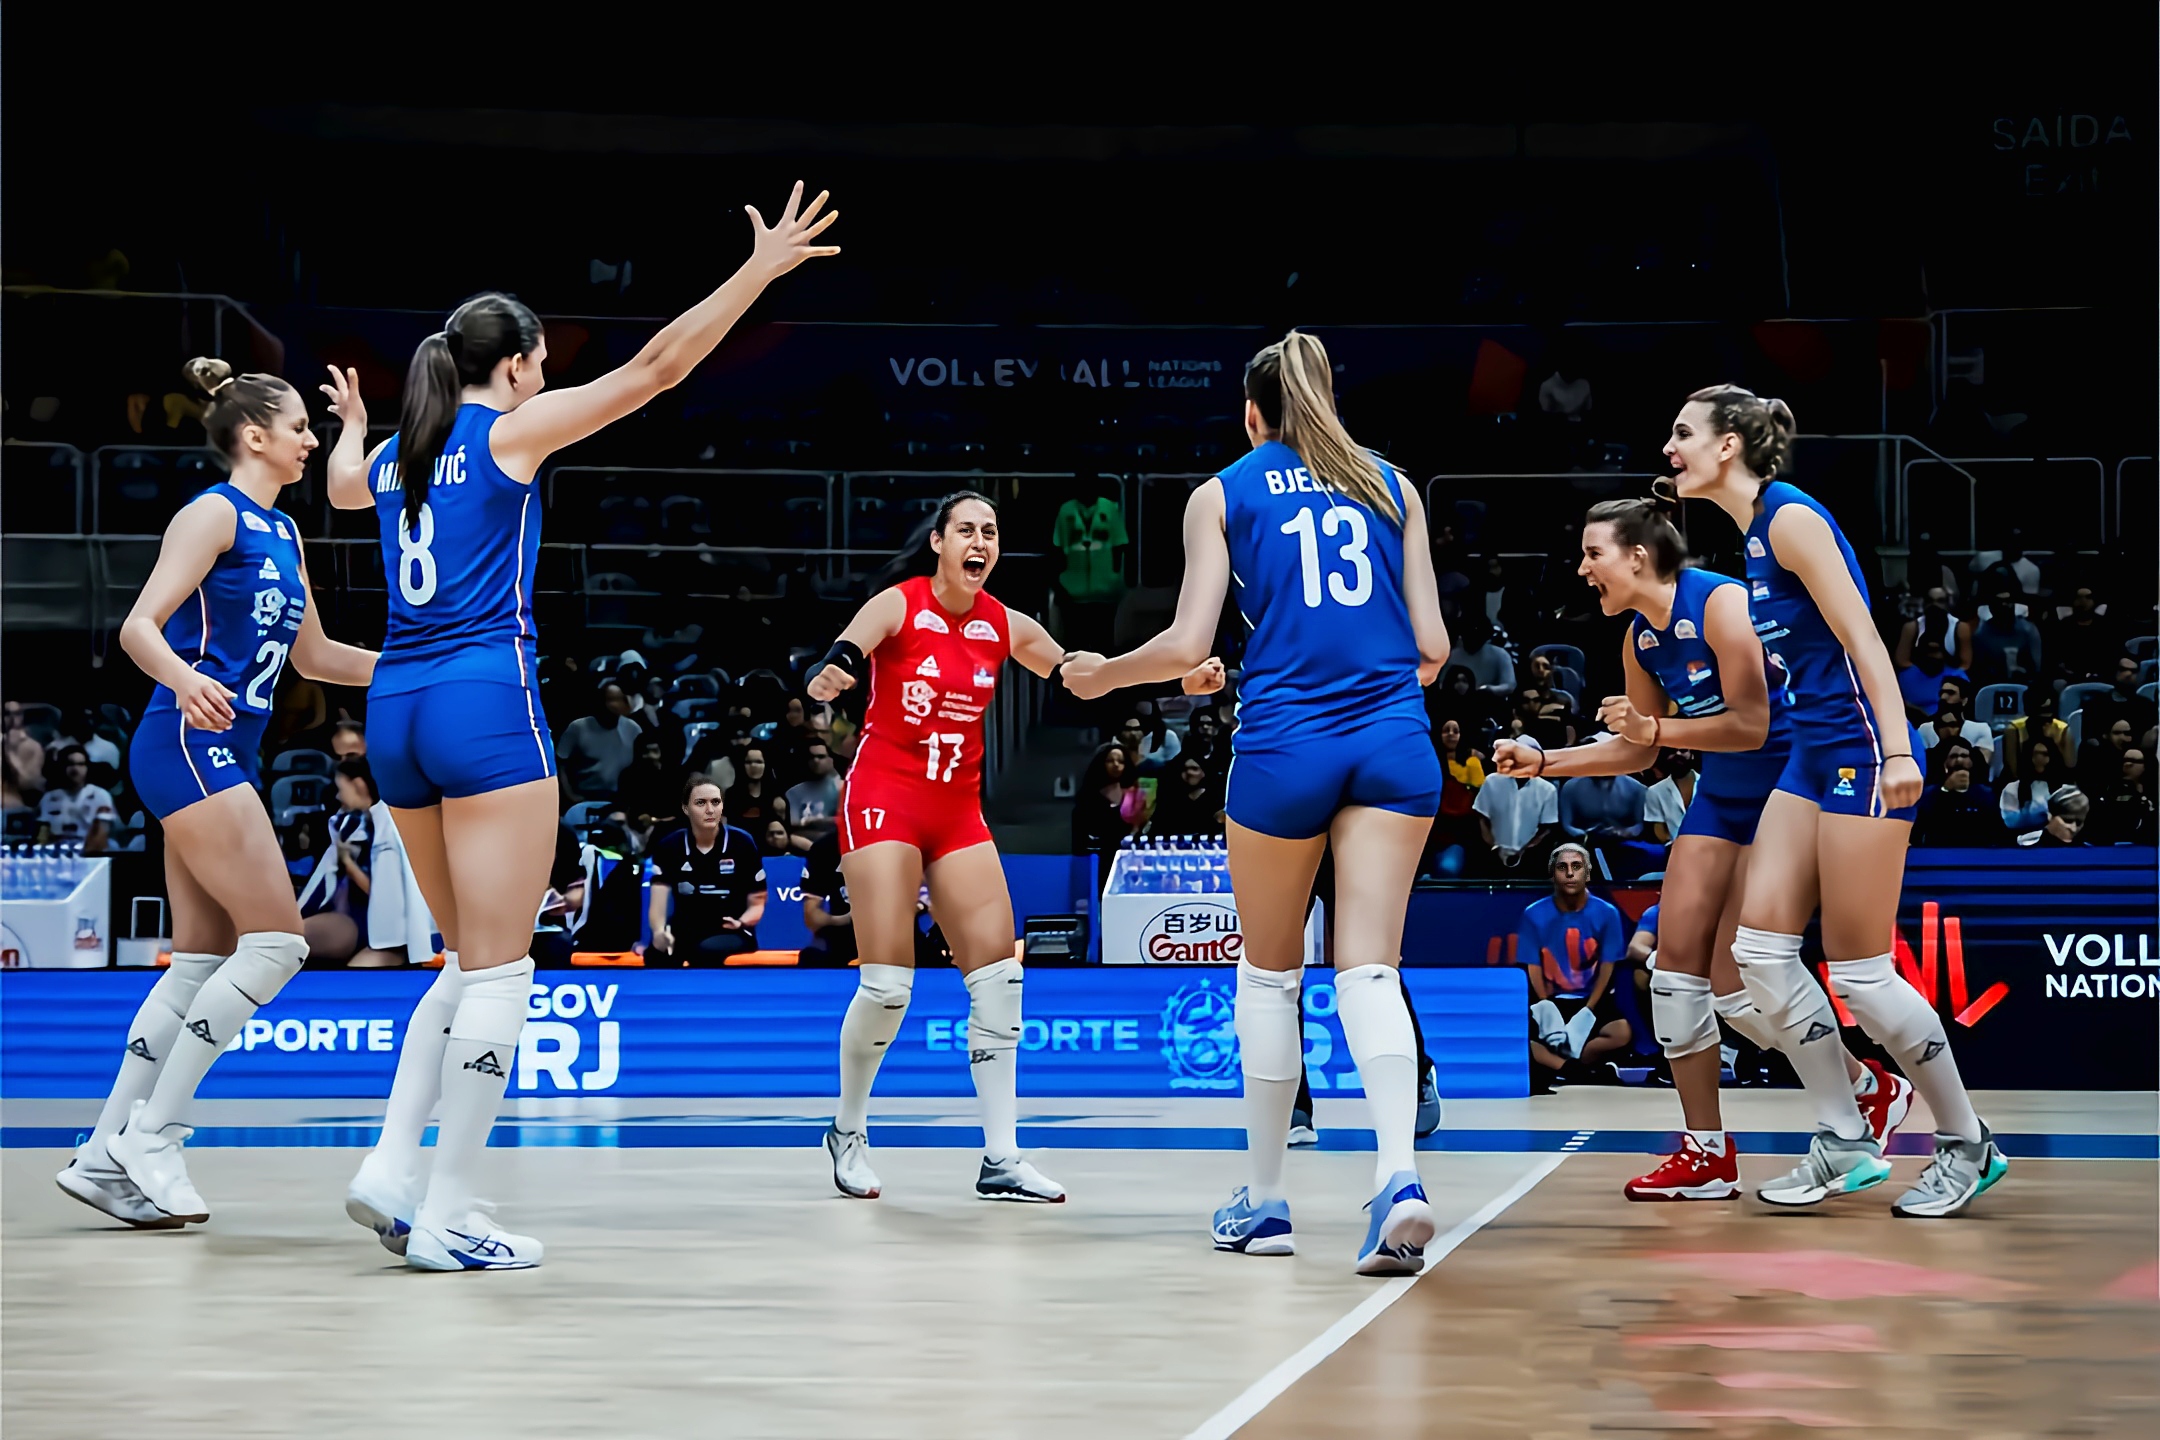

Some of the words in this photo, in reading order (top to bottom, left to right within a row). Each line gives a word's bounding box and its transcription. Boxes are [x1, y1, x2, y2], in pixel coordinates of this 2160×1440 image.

[398, 502, 437, 606] 8
[1280, 505, 1373, 608] 13
[919, 731, 965, 783] 17
[861, 807, 885, 830] 17
[1164, 912, 1238, 935] 百岁山
[527, 983, 619, 1019] GOV
[222, 1018, 394, 1052] PORTE
[926, 1019, 1140, 1052] ESORTE
[517, 1020, 620, 1091] RJ
